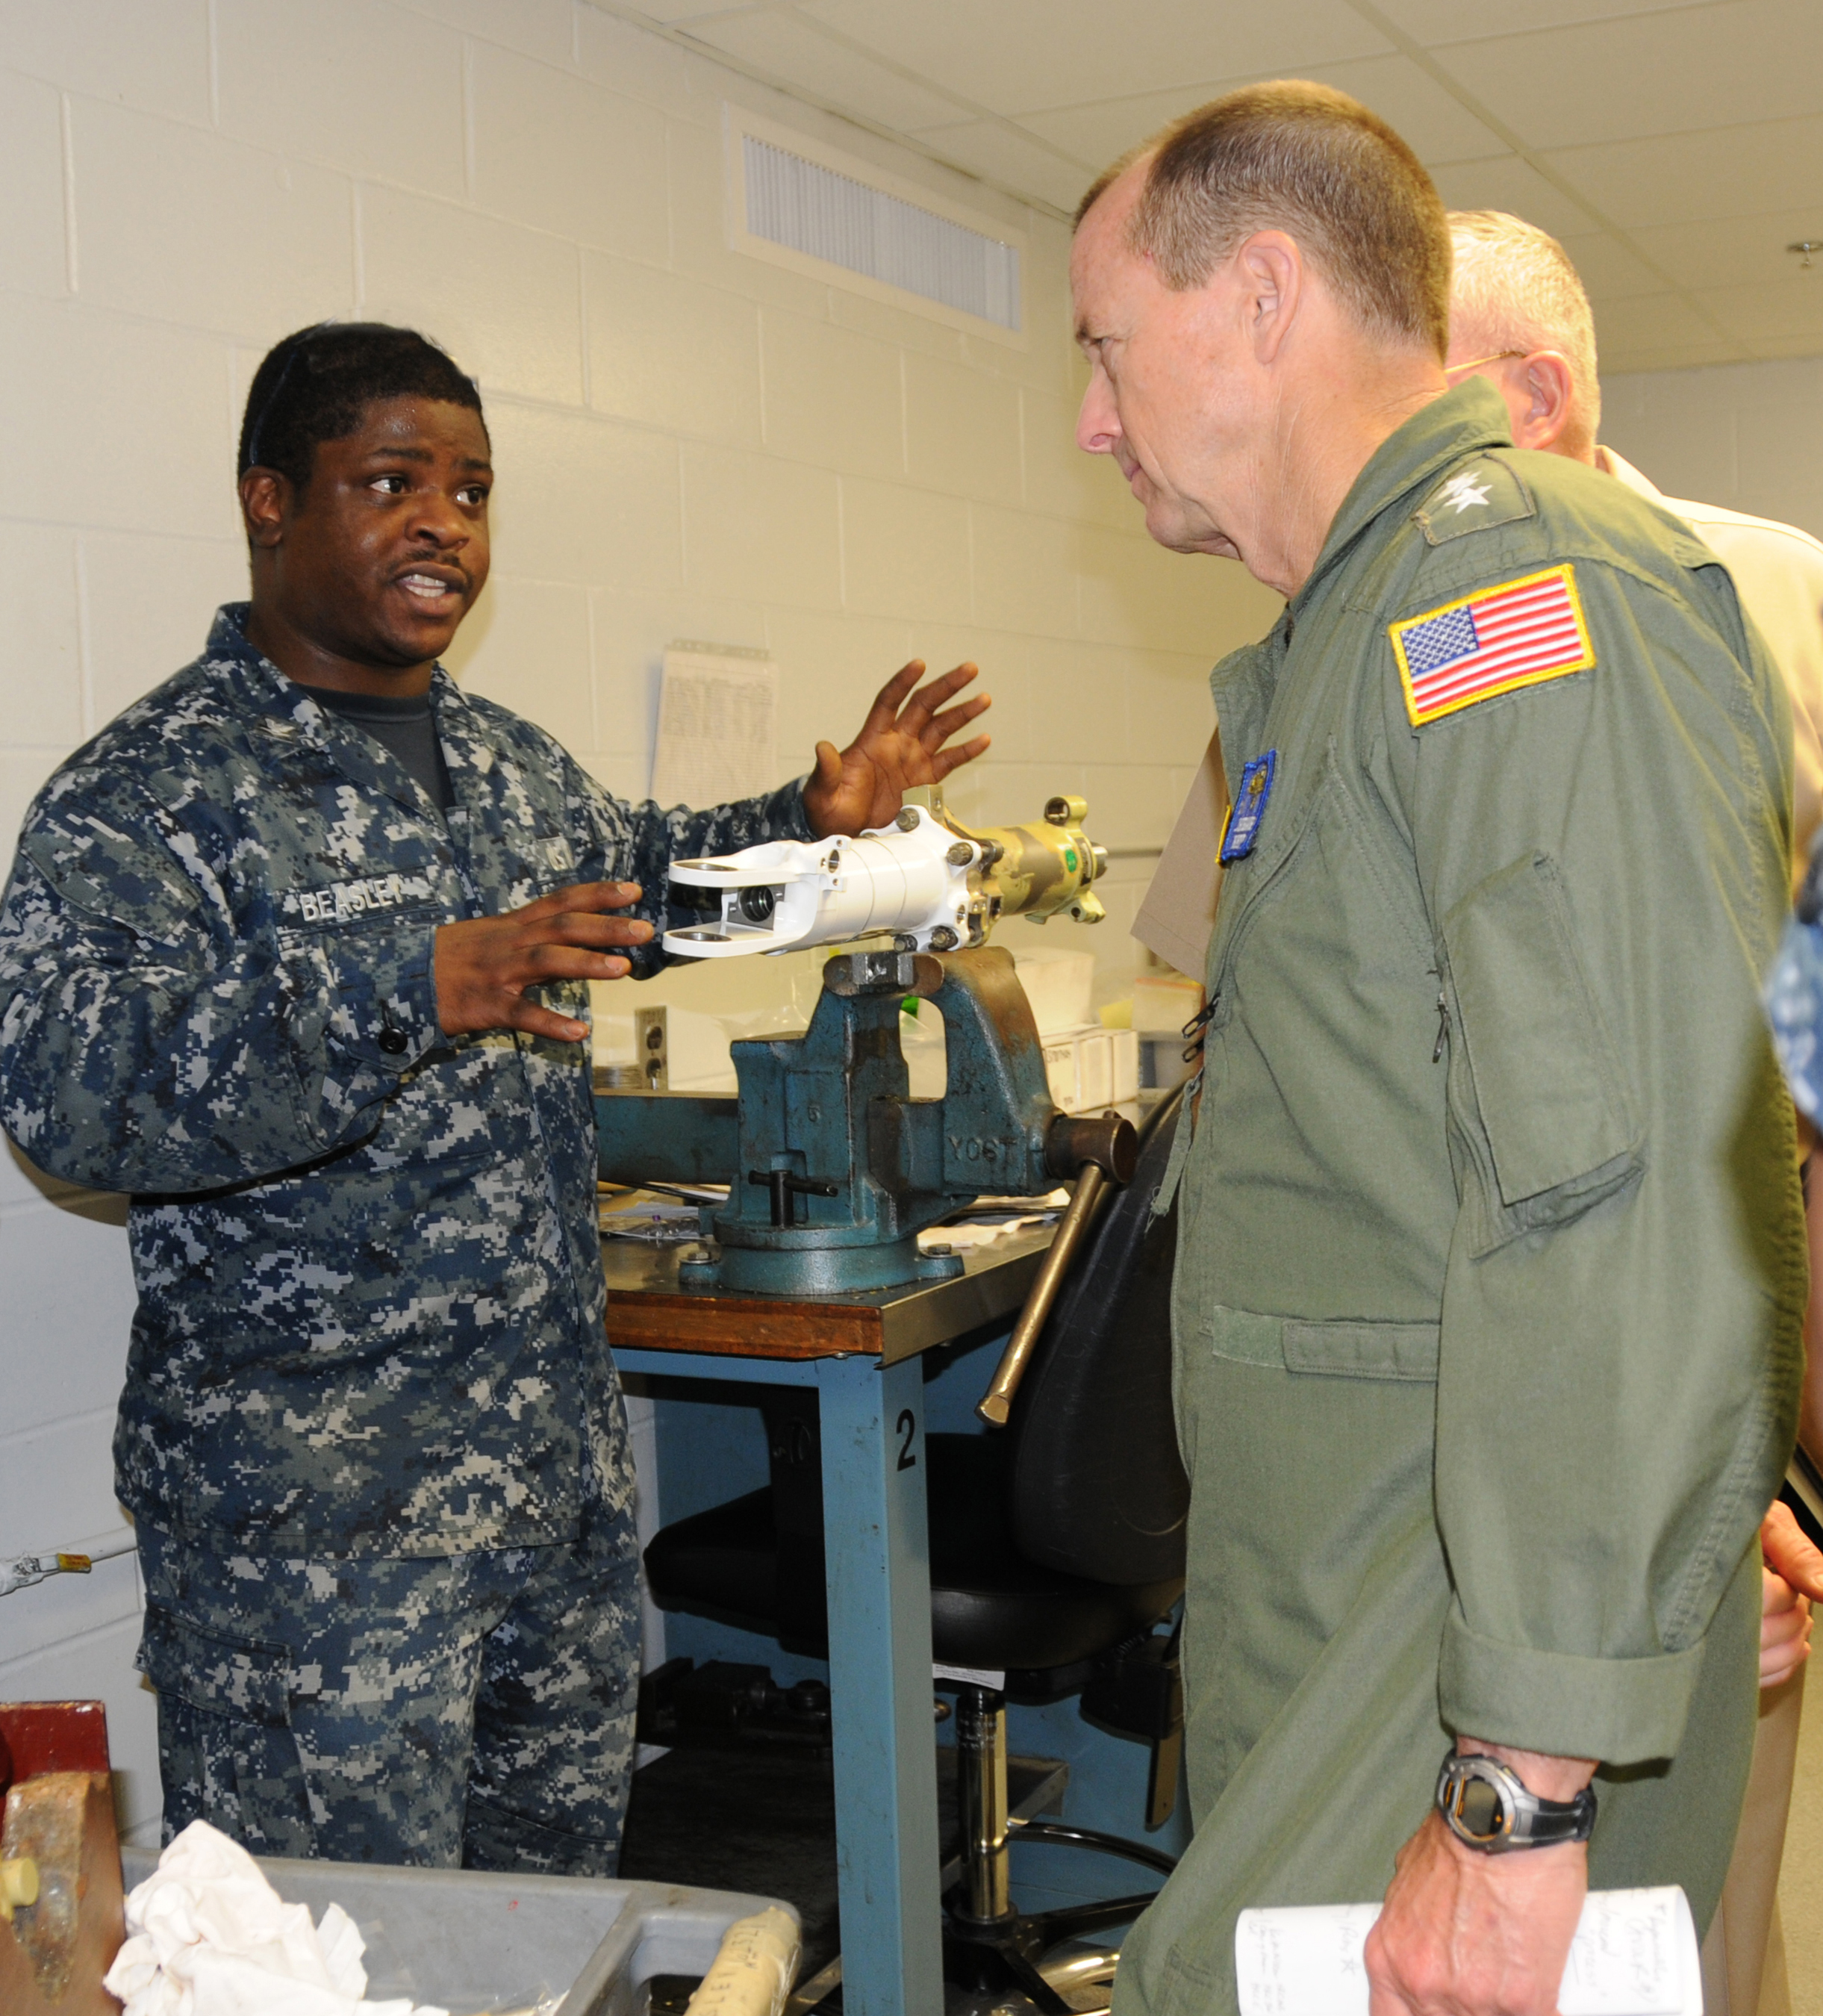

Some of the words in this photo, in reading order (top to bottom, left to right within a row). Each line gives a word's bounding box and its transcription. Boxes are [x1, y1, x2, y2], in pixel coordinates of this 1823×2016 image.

[299, 877, 403, 922] BEASLEY
[947, 1135, 1017, 1163] YOST
[897, 1409, 916, 1472] 2
